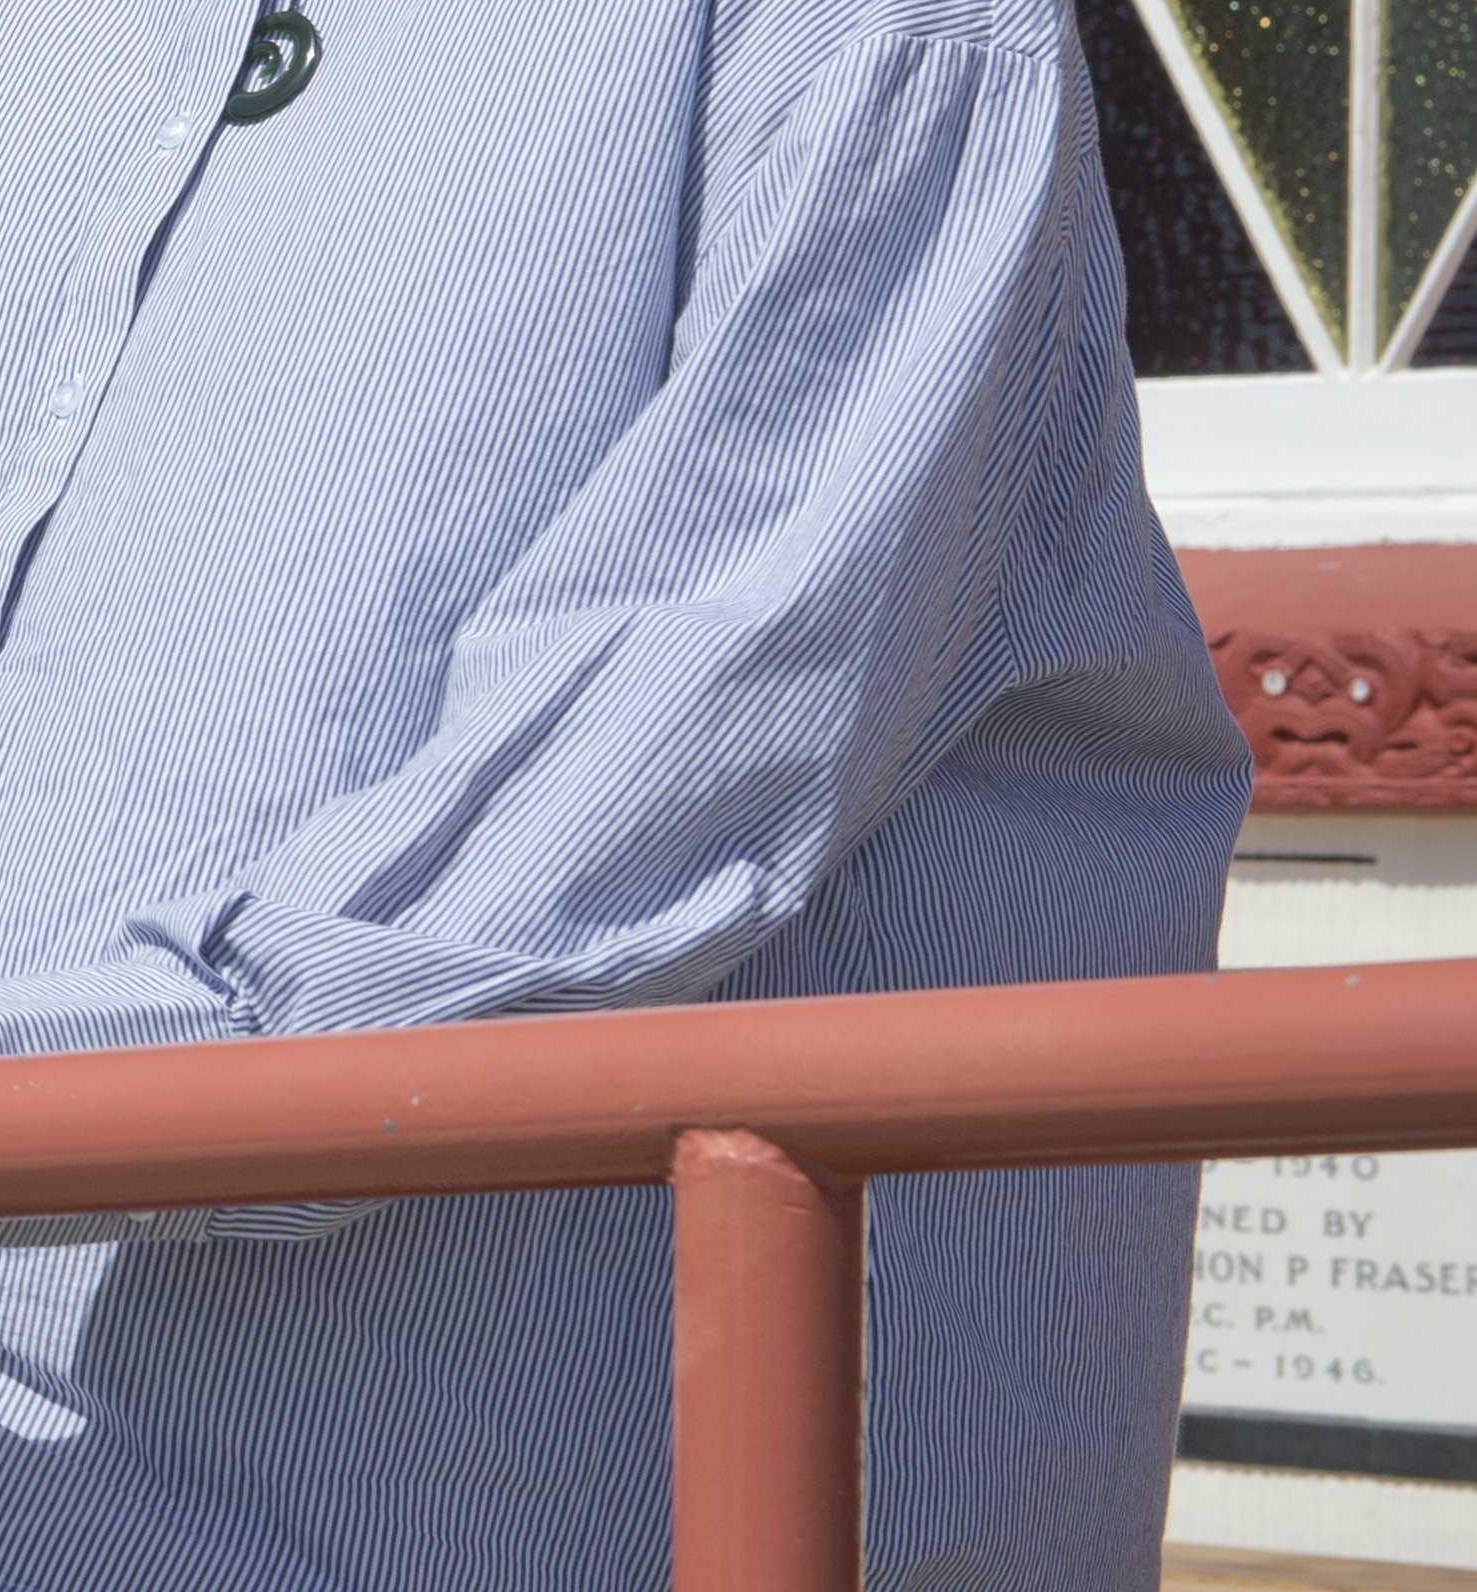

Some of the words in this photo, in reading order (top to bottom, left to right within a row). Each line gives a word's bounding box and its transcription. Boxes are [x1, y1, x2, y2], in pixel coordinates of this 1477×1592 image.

[1274, 1154, 1380, 1181] 1940
[1323, 1209, 1375, 1239] BY
[1287, 1254, 1309, 1287] P
[1254, 1306, 1325, 1334] P.M.
[1275, 1353, 1386, 1386] 1946.
